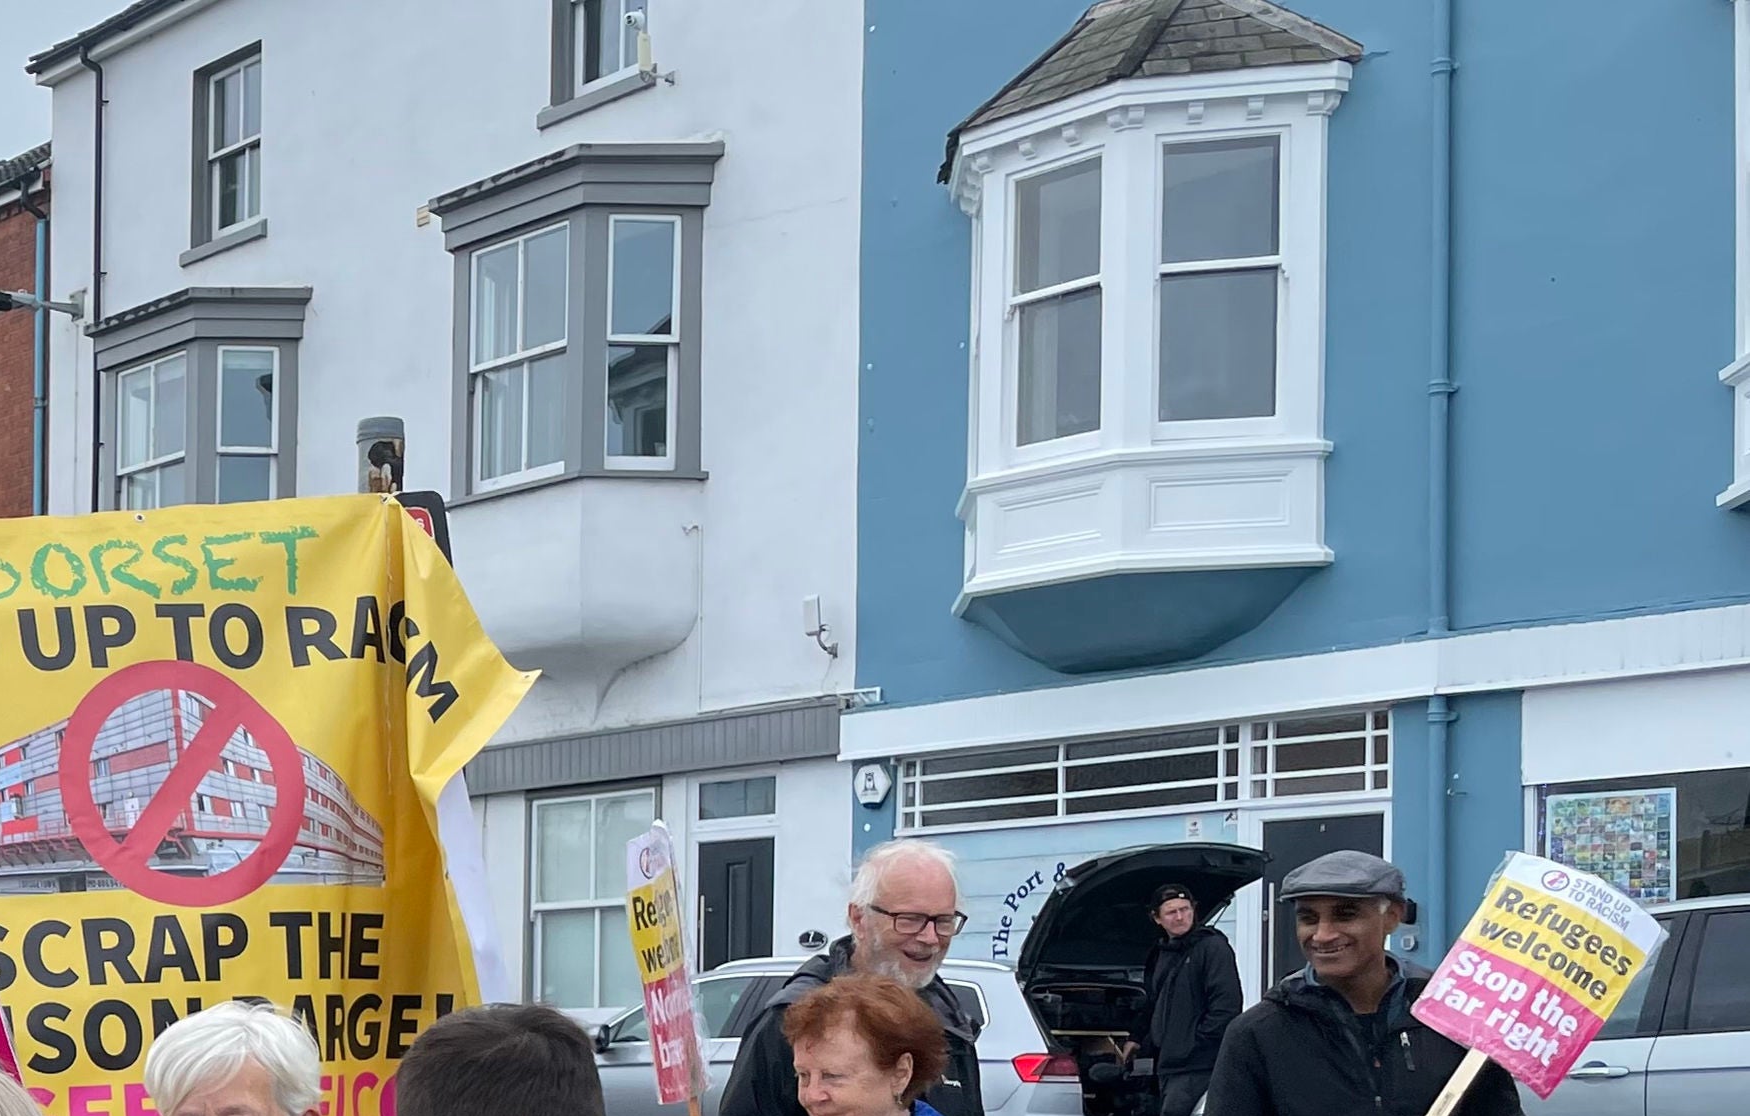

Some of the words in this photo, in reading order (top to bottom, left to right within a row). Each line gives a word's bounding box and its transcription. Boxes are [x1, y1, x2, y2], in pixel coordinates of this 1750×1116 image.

[18, 603, 137, 671] UP
[156, 602, 266, 669] TO
[992, 915, 1012, 960] The
[1003, 870, 1044, 912] Port
[1495, 886, 1633, 977] Refugees
[1568, 888, 1586, 903] TO
[1585, 897, 1632, 931] RACISM
[1573, 878, 1615, 905] STAND
[1614, 899, 1632, 914] UP
[270, 912, 384, 980] THE
[1479, 918, 1608, 1001] welcome
[1432, 977, 1486, 1017] far
[1485, 1008, 1561, 1068] right
[1452, 950, 1528, 1003] Stop
[1530, 988, 1578, 1039] the
